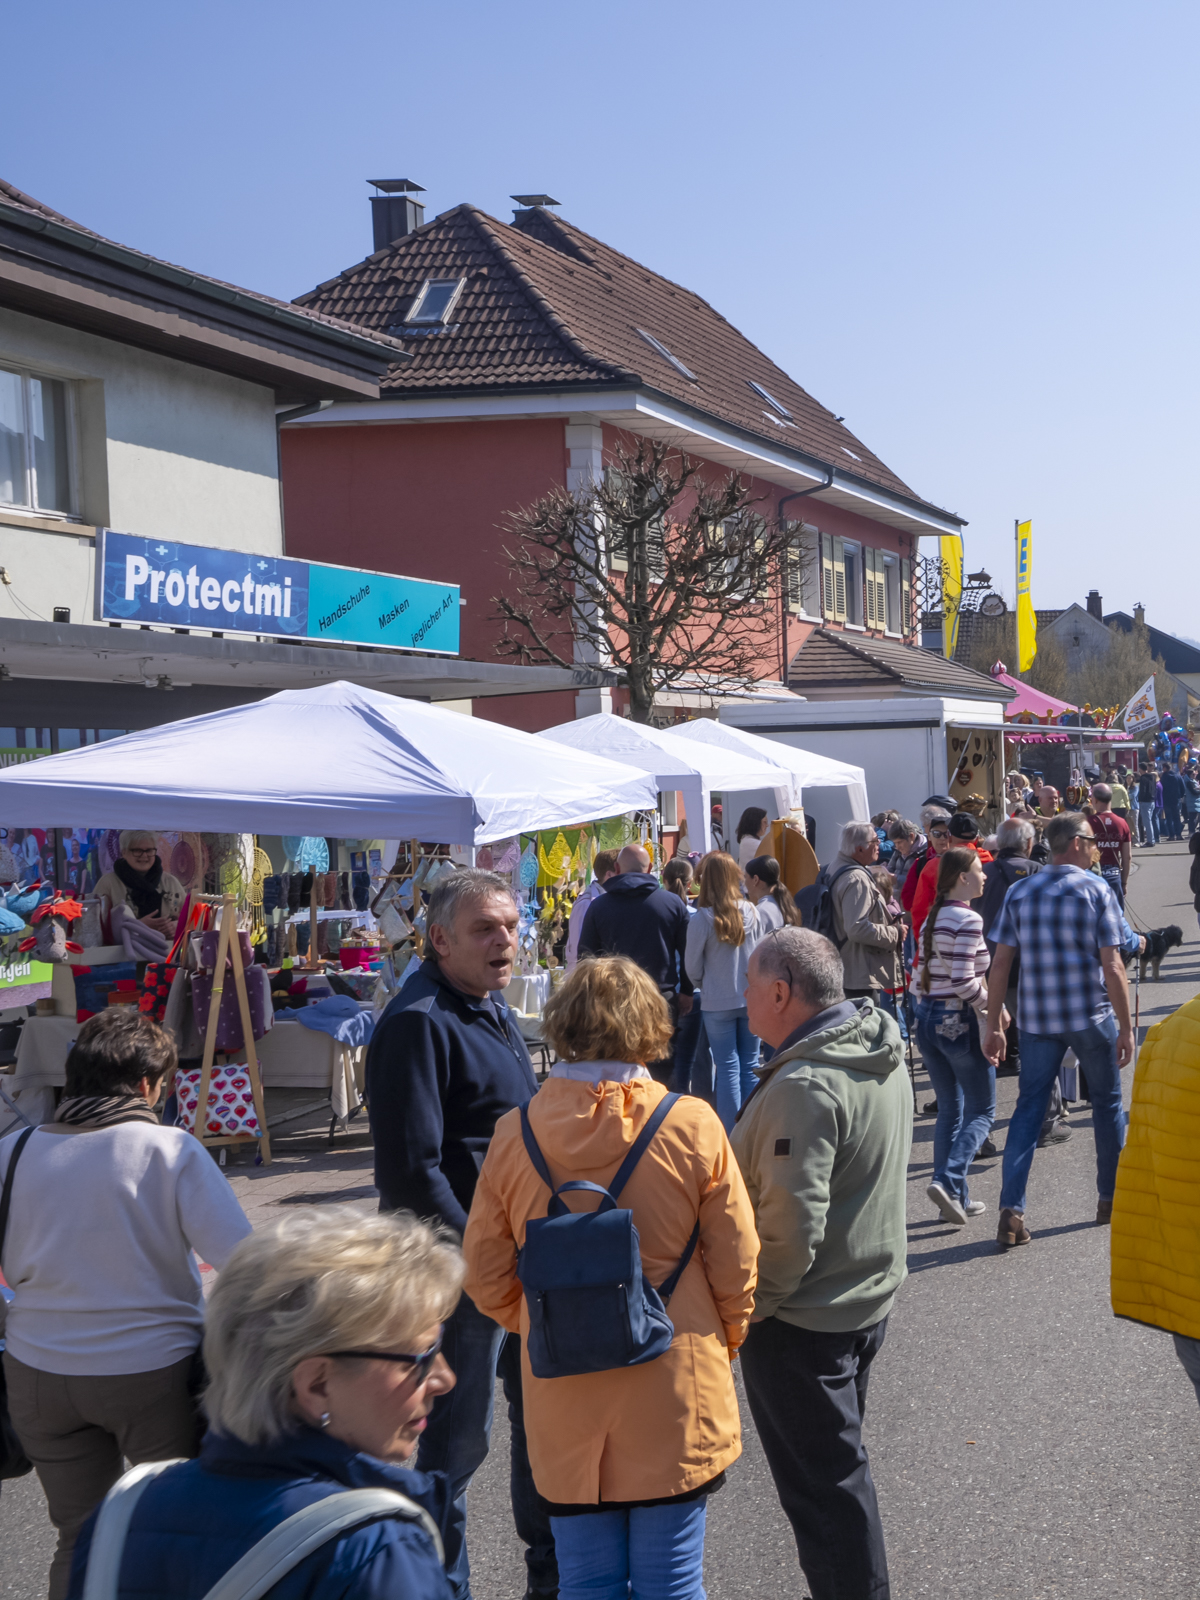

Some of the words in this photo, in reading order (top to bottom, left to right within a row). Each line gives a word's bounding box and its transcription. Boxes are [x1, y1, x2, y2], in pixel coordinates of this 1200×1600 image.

[125, 554, 292, 618] Protectmi
[318, 584, 371, 632] Handschuhe
[378, 598, 410, 630] Masken
[411, 607, 442, 648] jeglicher
[442, 593, 454, 612] Art
